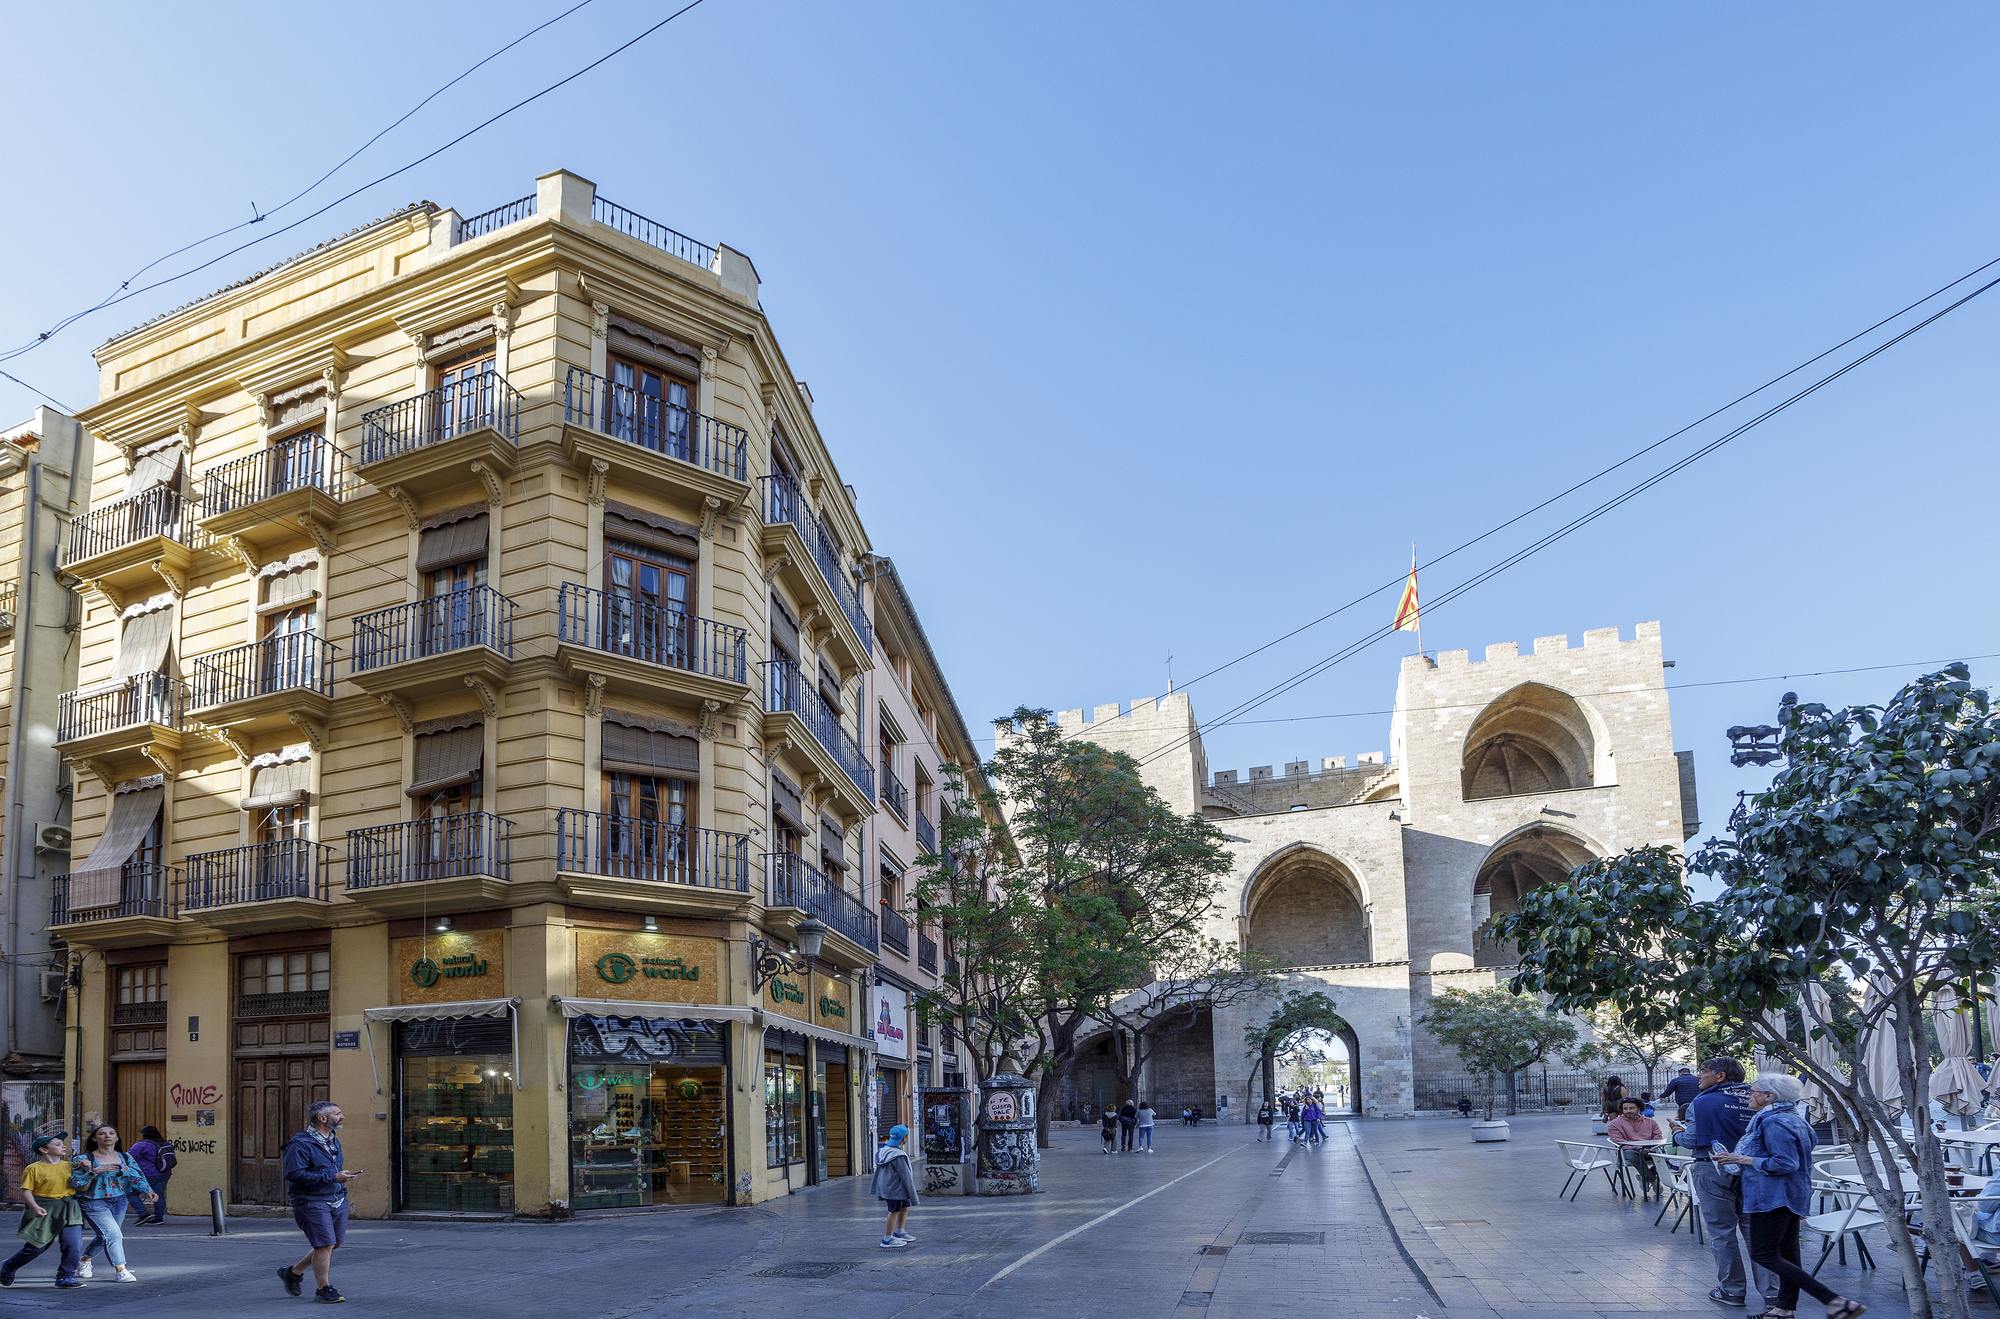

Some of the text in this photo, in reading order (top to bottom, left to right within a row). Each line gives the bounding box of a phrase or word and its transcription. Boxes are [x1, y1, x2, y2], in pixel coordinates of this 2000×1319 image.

[444, 960, 487, 977] world
[642, 965, 700, 980] world
[188, 1140, 217, 1155] NORTE
